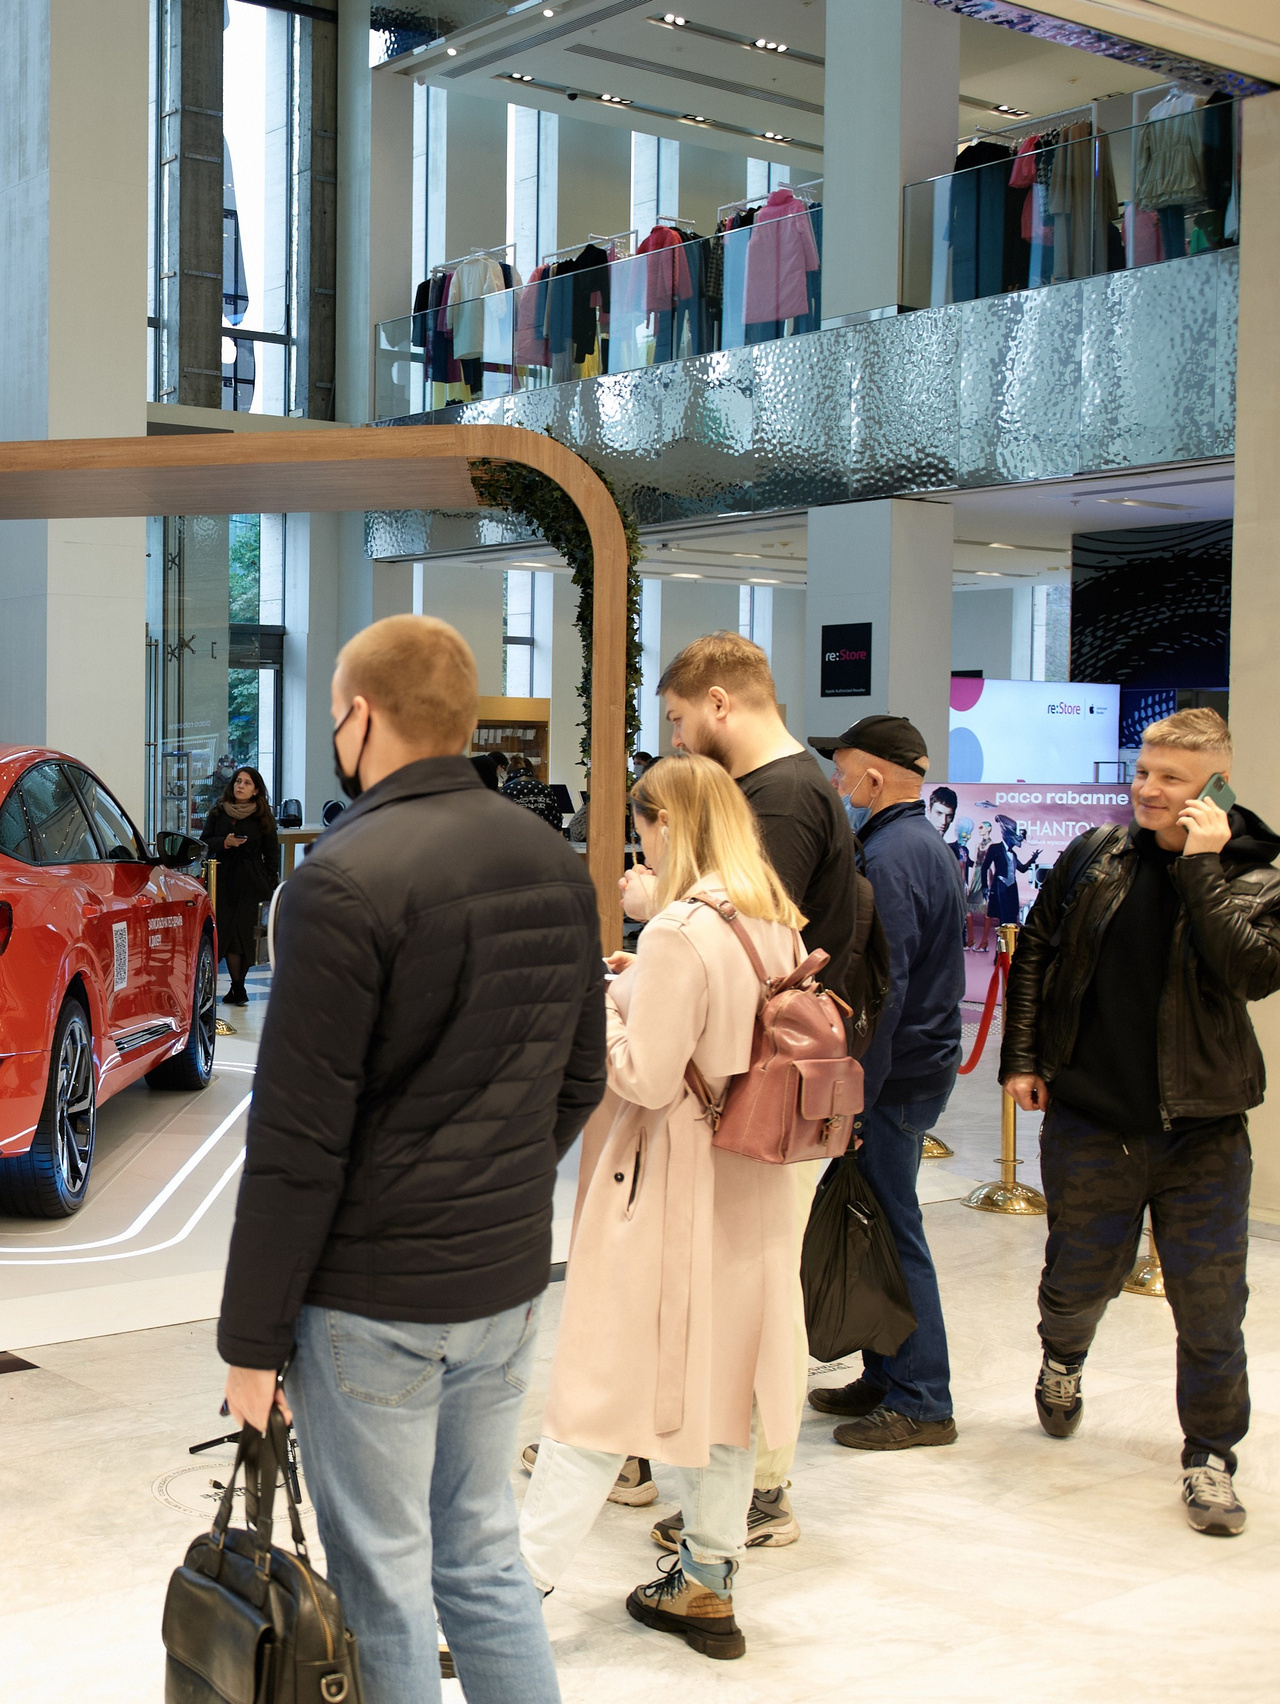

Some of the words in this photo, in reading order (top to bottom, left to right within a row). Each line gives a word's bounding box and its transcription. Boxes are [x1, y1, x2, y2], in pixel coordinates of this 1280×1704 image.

[825, 648, 866, 661] re:Store
[1047, 701, 1081, 715] re:Store
[995, 791, 1042, 805] paco
[1046, 790, 1129, 805] rabanne
[1017, 820, 1095, 837] PHANTO
